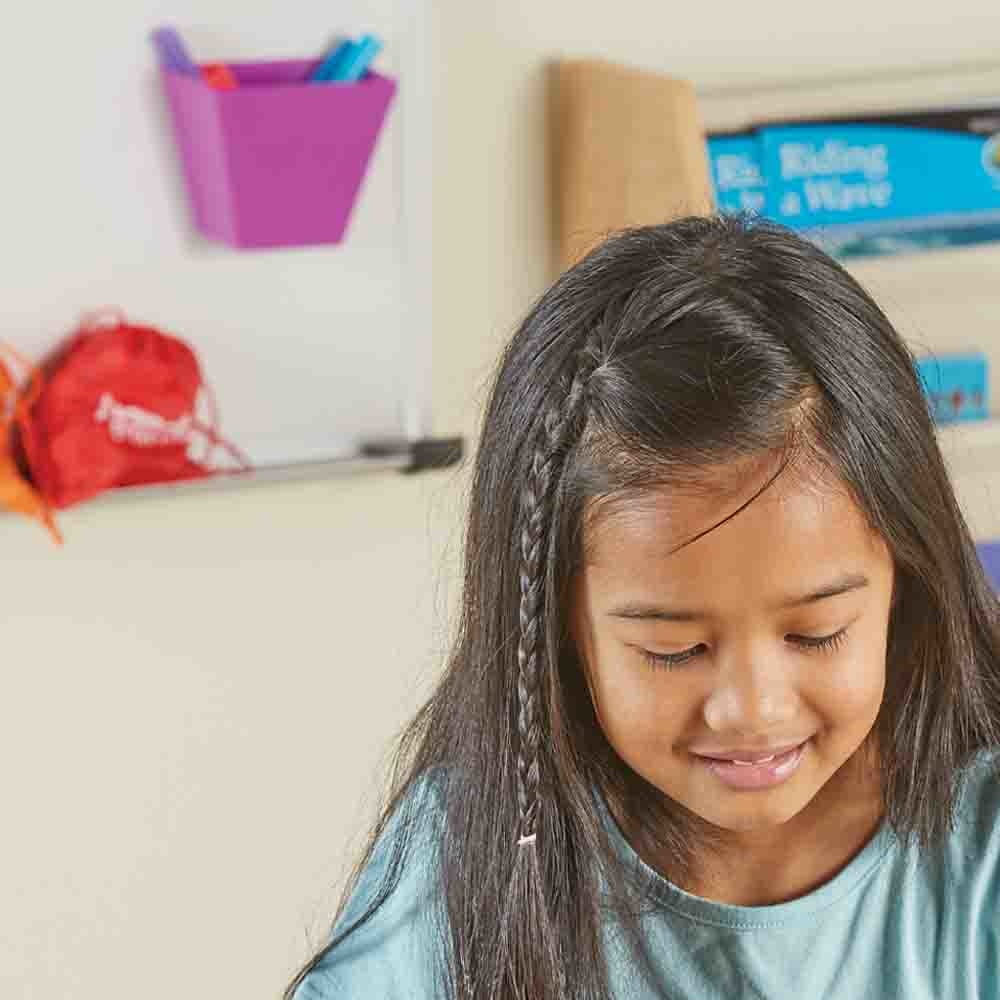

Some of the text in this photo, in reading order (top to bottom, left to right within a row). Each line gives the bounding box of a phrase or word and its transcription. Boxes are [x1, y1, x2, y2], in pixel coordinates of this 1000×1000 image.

[779, 140, 888, 181] Riding
[779, 192, 801, 216] a
[805, 179, 893, 211] Wave
